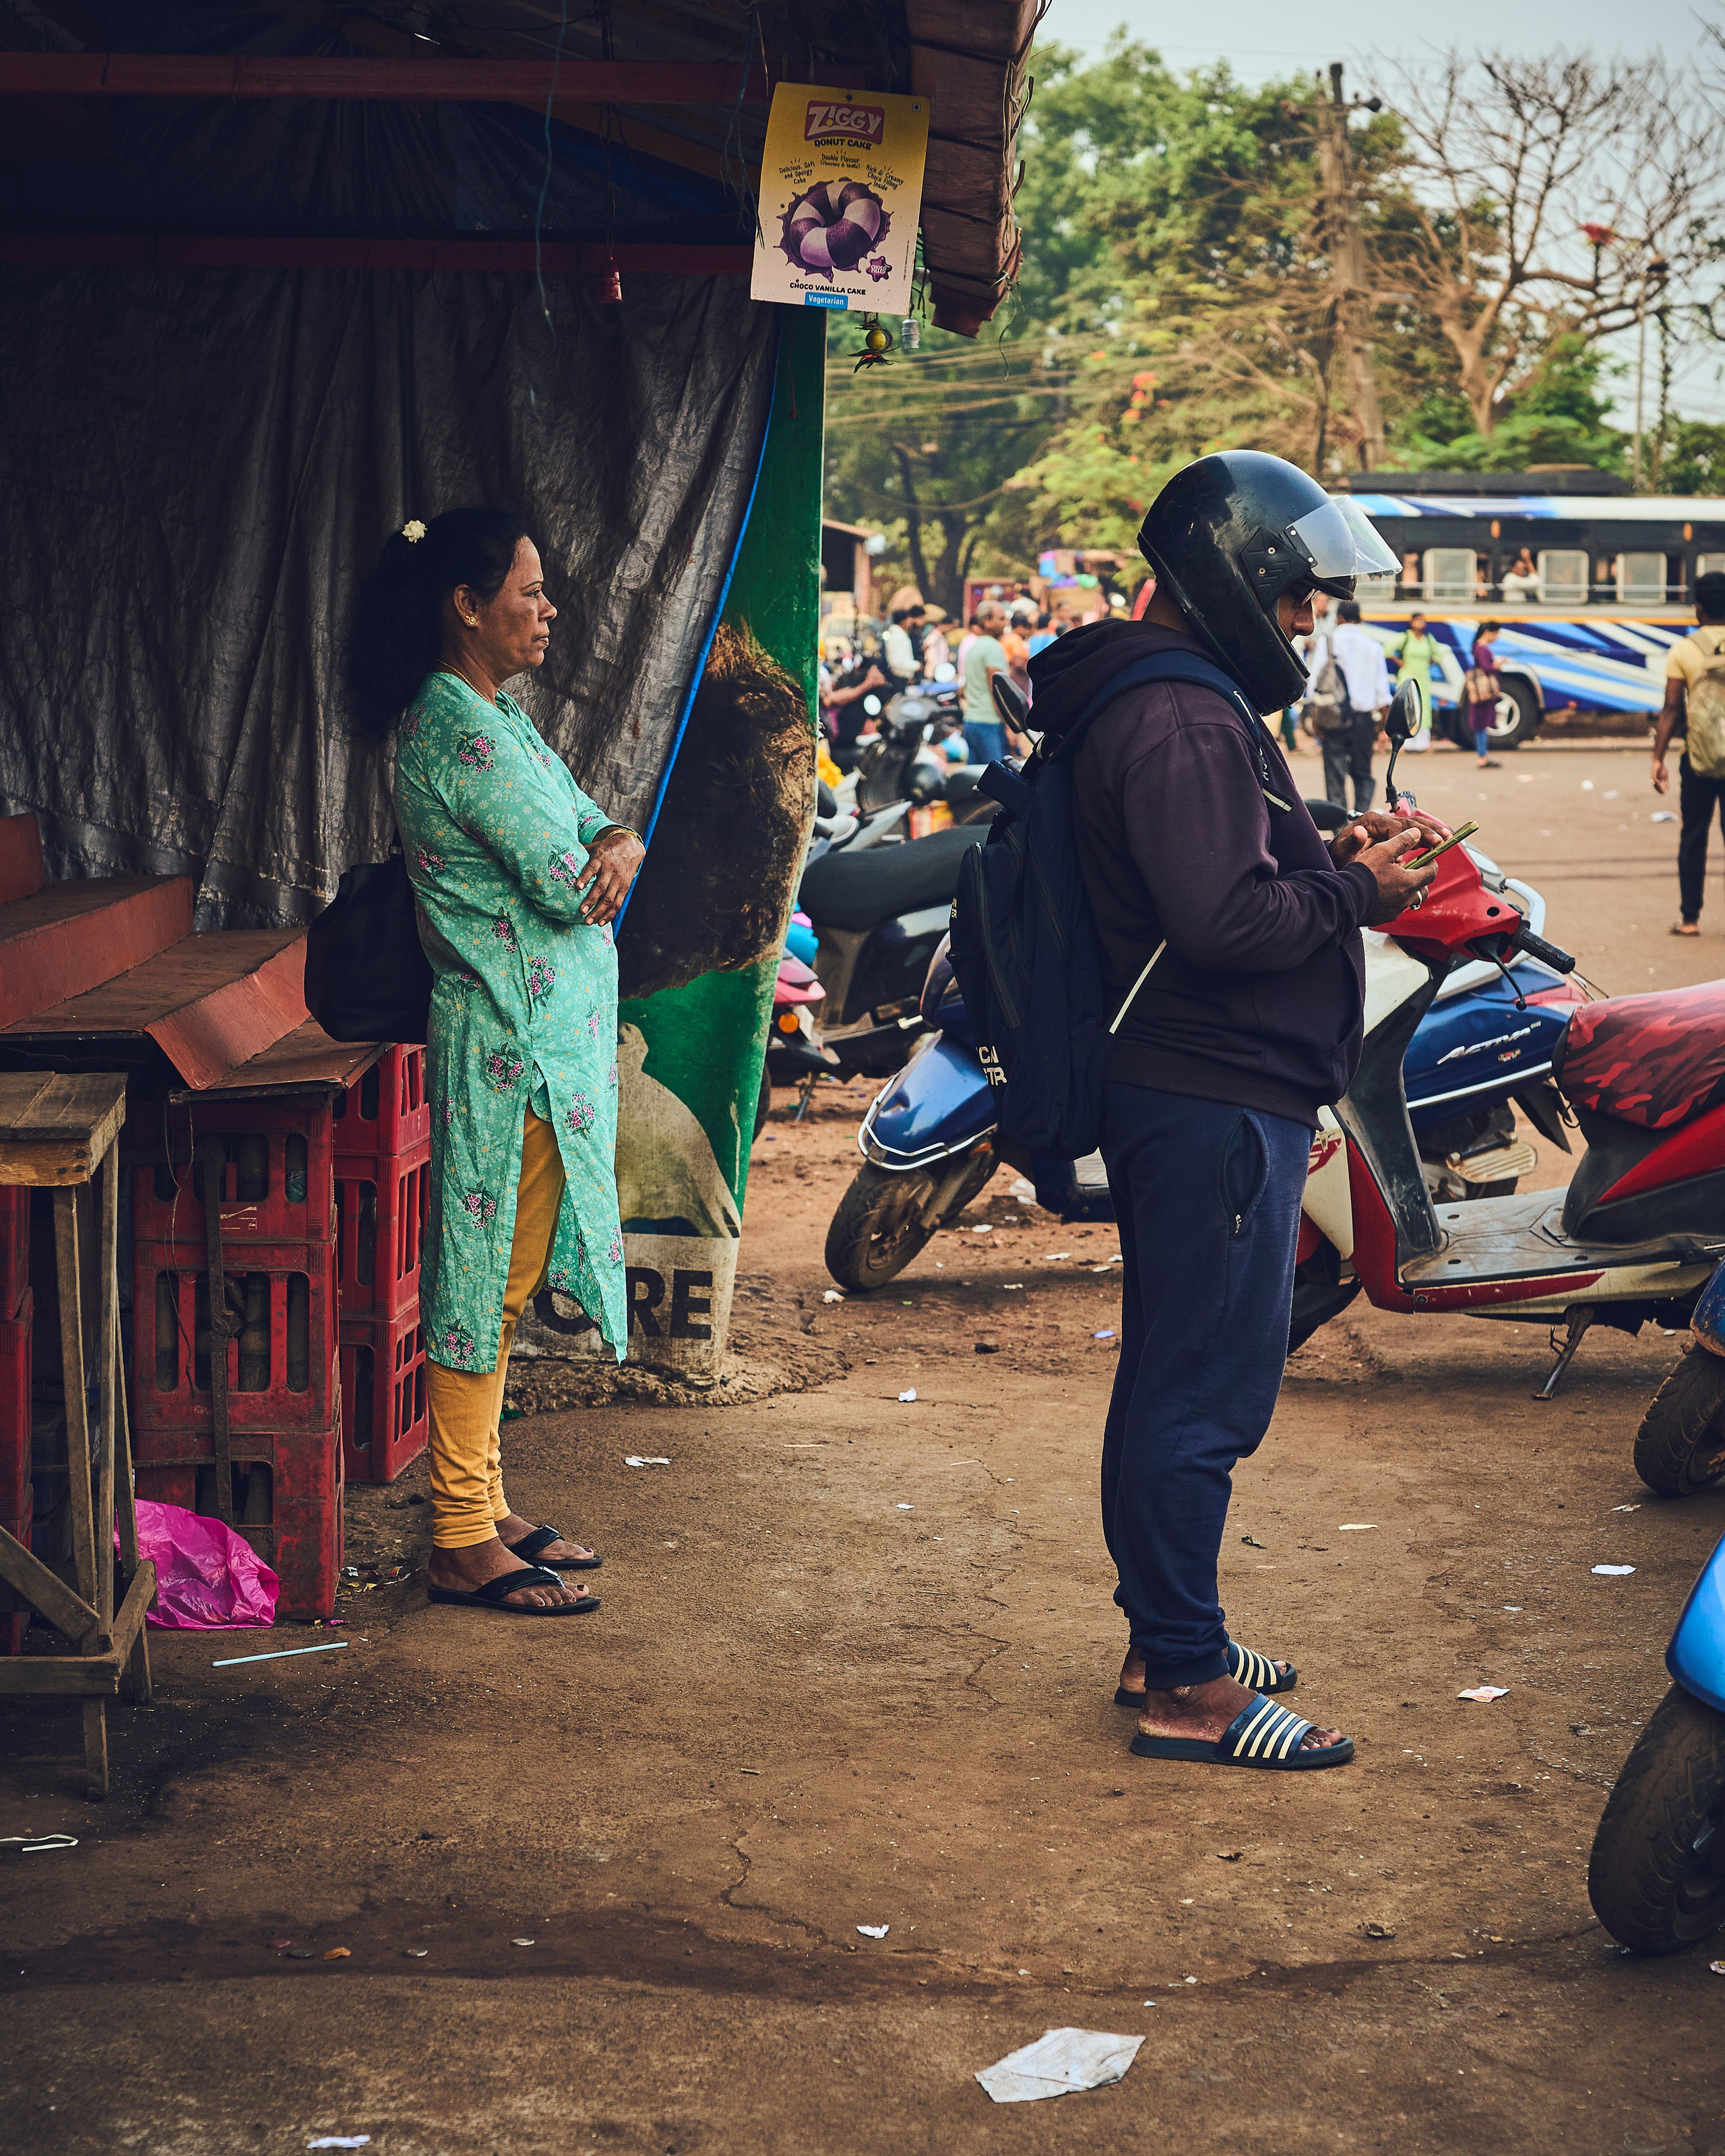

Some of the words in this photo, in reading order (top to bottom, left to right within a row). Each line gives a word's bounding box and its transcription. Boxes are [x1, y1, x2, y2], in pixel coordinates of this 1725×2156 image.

[814, 138, 846, 148] DONUT
[847, 139, 873, 150] CAKE
[821, 154, 839, 162] Double
[840, 155, 860, 163] Flavour
[795, 168, 813, 179] Spongy
[866, 164, 877, 173] Rich
[885, 172, 904, 185] Creamy
[867, 171, 883, 181] Choco
[883, 177, 899, 190] Filling
[873, 181, 888, 191] Inside
[790, 282, 814, 290] CHOCO
[815, 284, 846, 293] VANILLA
[809, 294, 844, 305] Vegetarian
